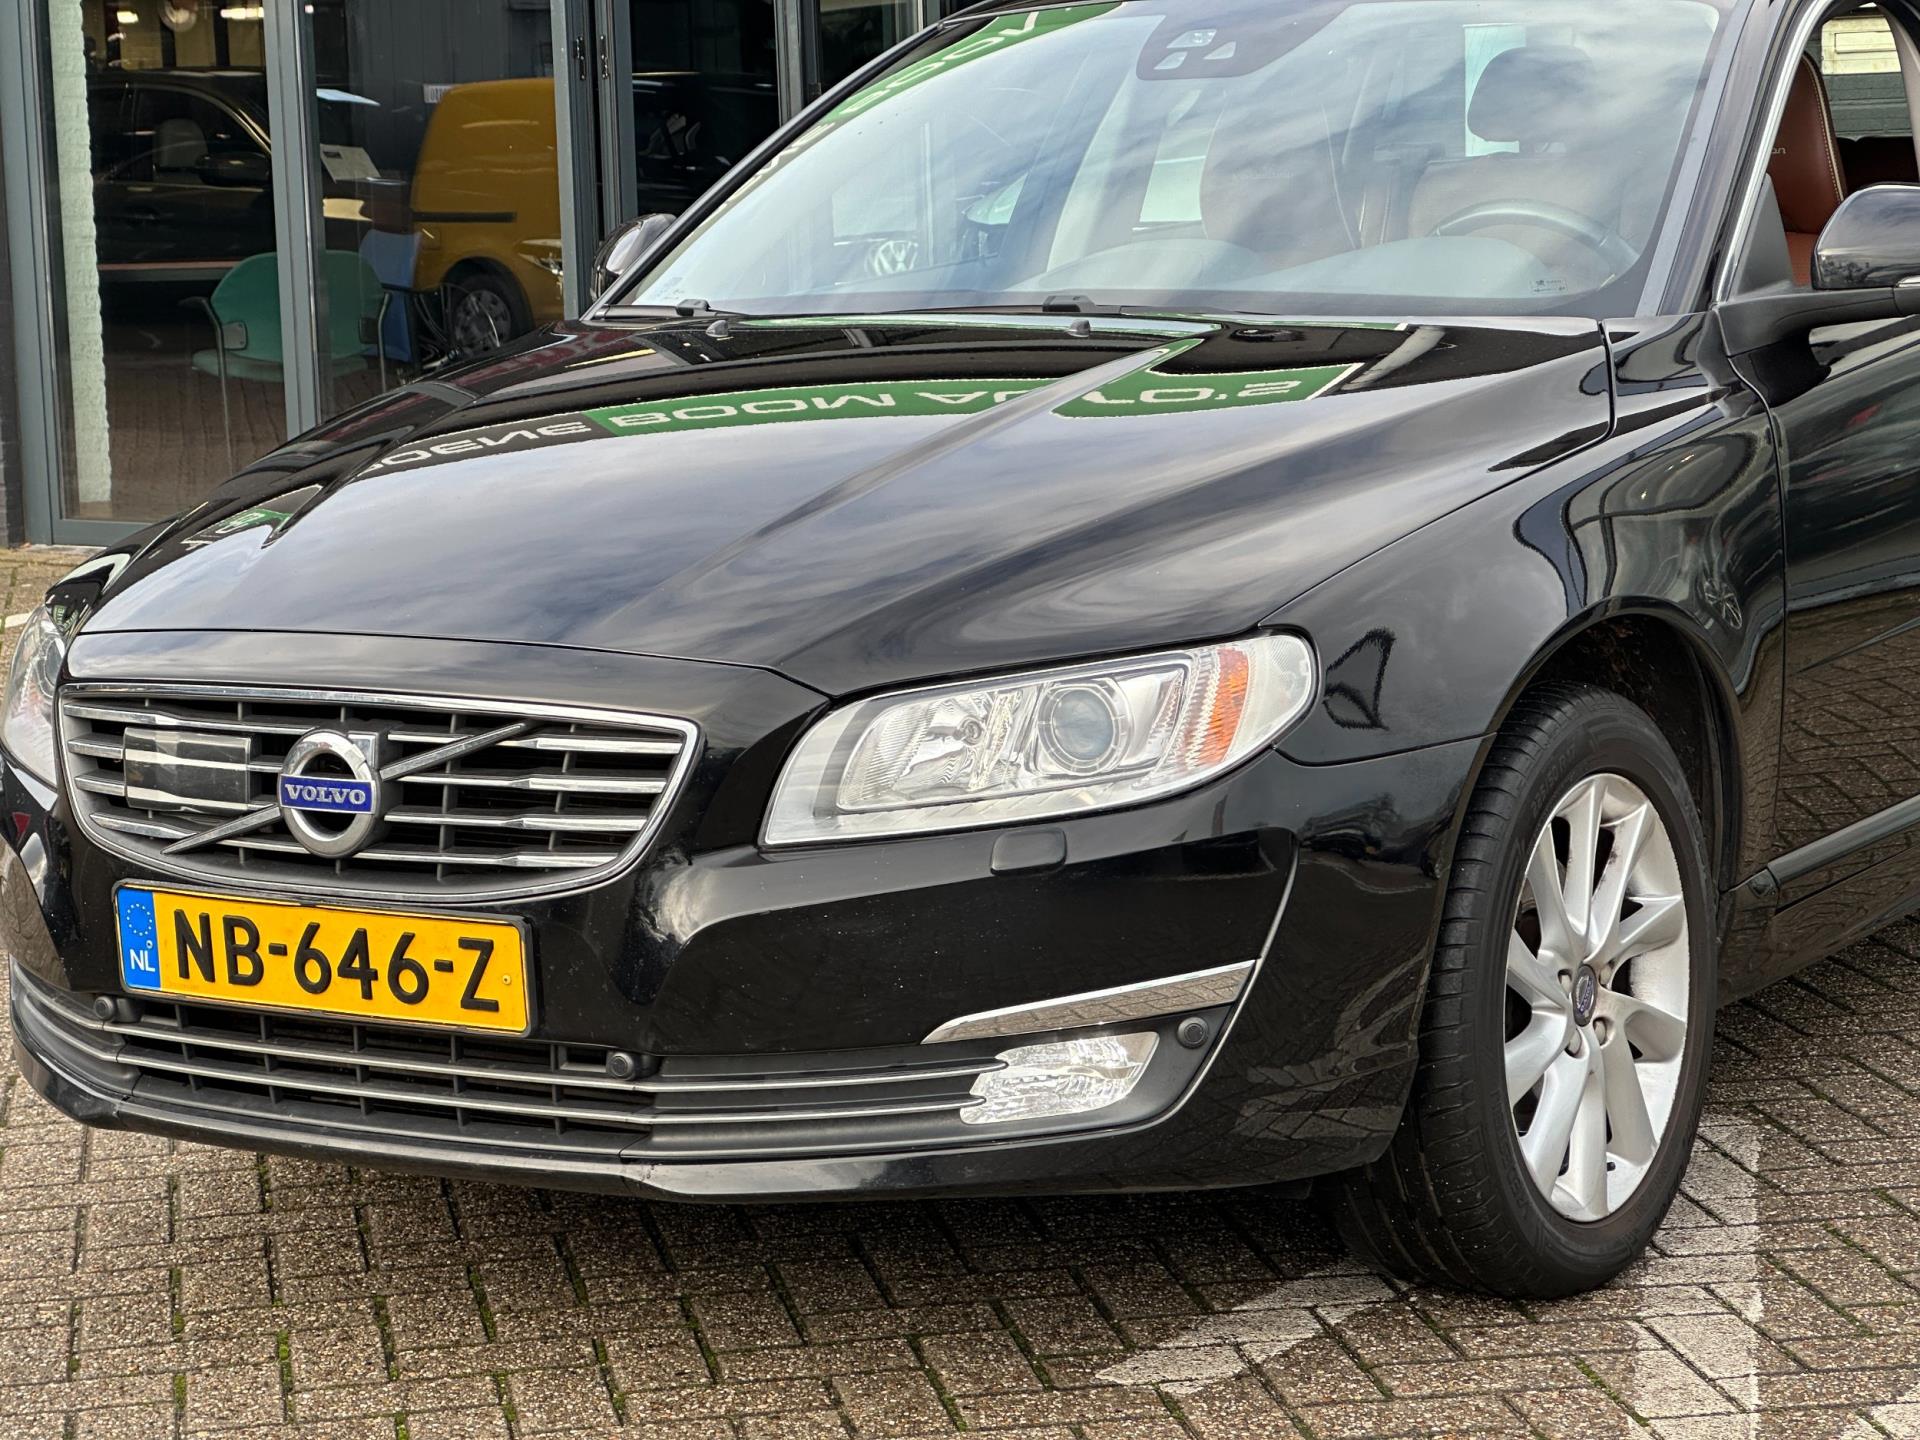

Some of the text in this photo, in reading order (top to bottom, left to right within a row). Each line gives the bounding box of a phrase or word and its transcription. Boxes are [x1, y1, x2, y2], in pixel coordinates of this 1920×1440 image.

[284, 783, 366, 805] VOLVO
[129, 948, 156, 973] NL
[173, 908, 500, 1013] NB-646-Z
